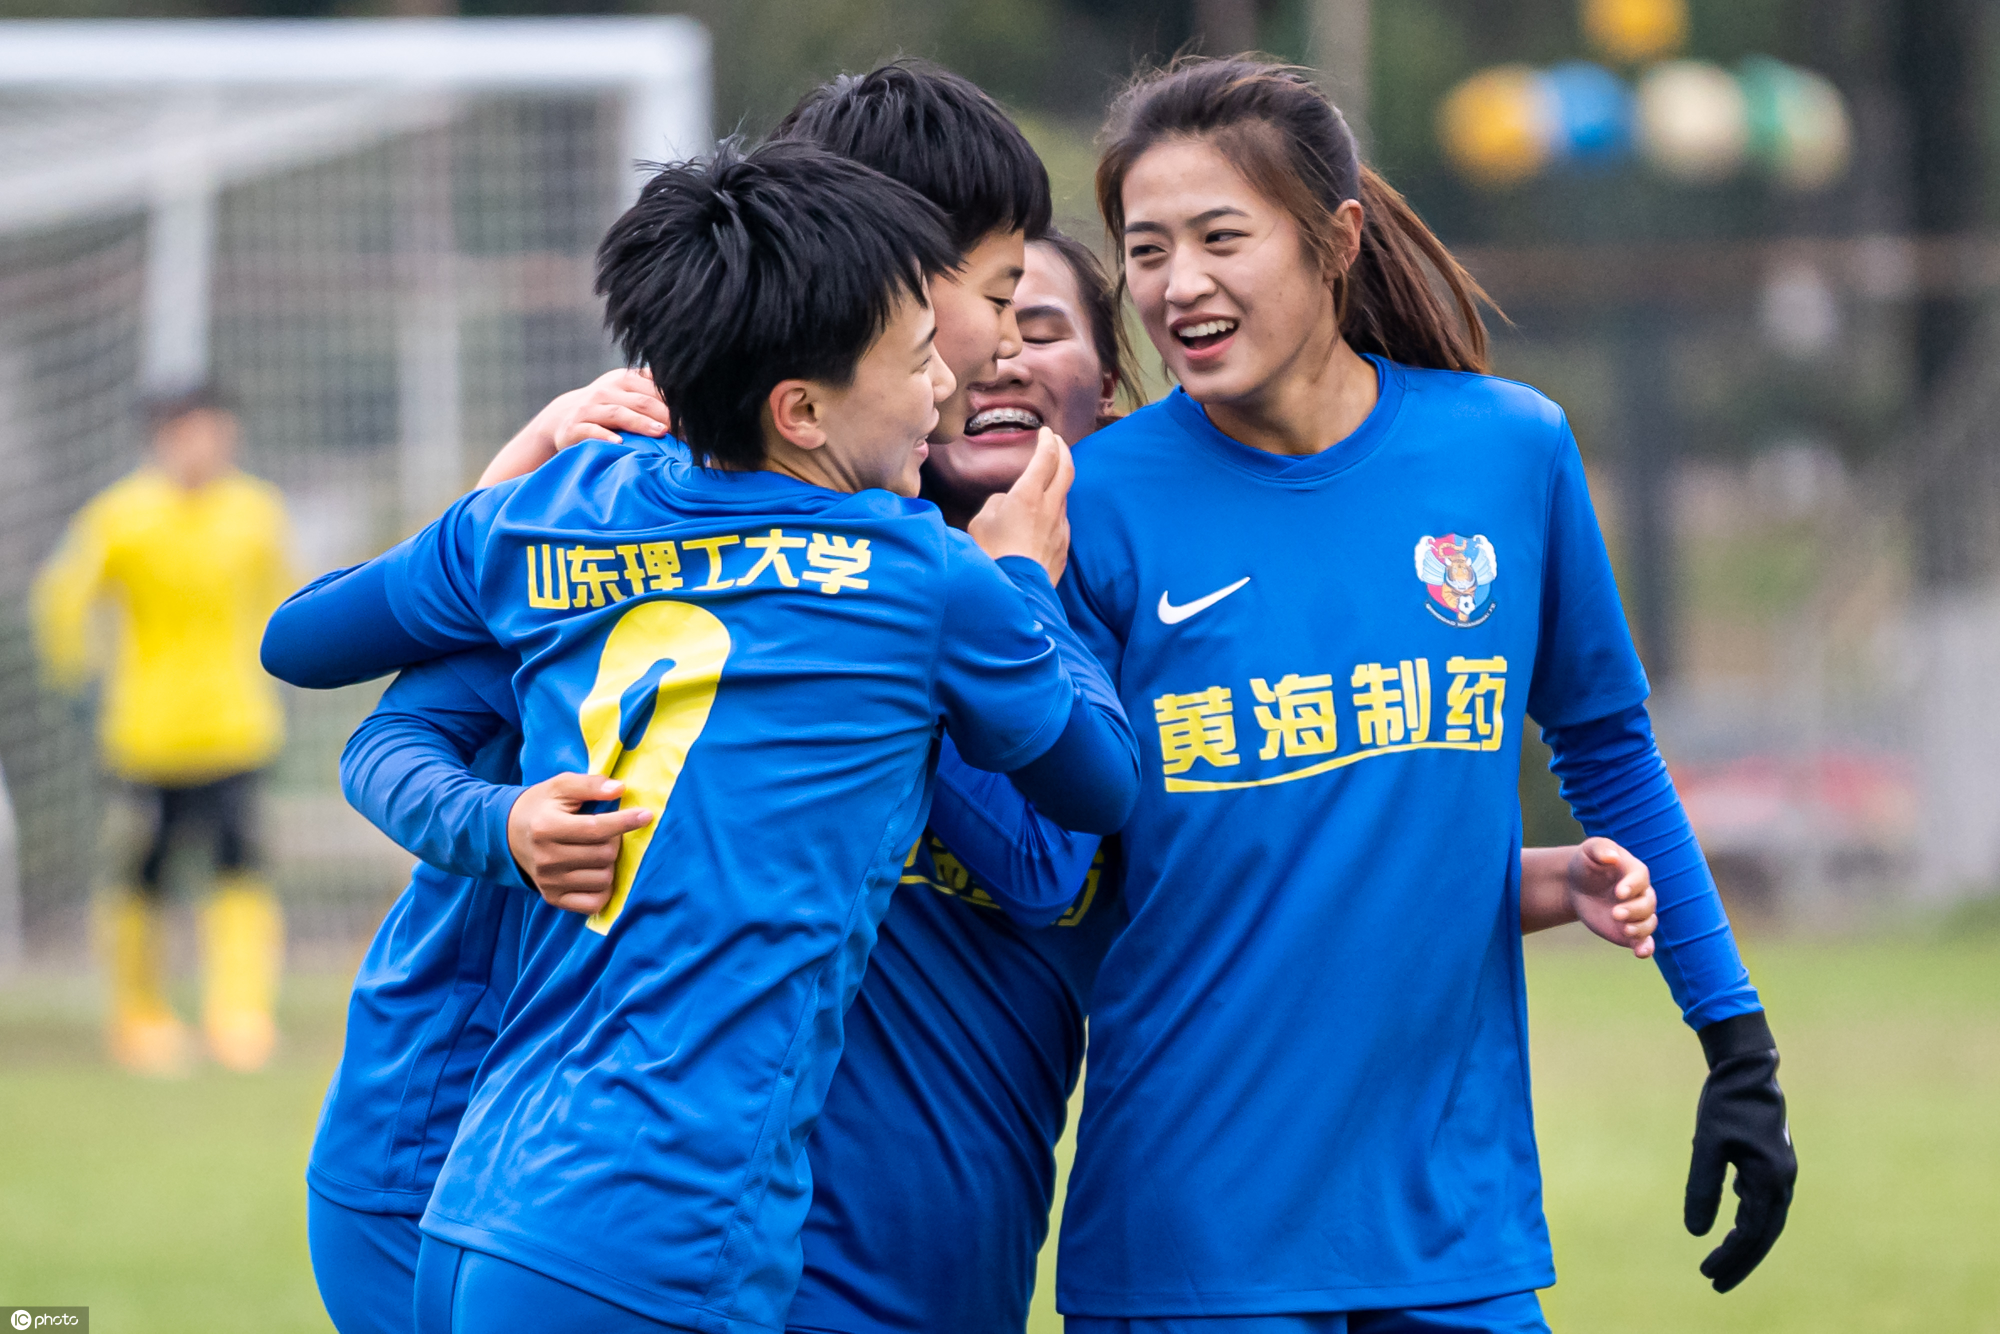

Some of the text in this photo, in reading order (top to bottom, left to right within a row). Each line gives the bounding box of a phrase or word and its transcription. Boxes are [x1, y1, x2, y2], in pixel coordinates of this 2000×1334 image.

[527, 528, 871, 610] 山东理工大学
[1154, 656, 1507, 775] 黄海制药
